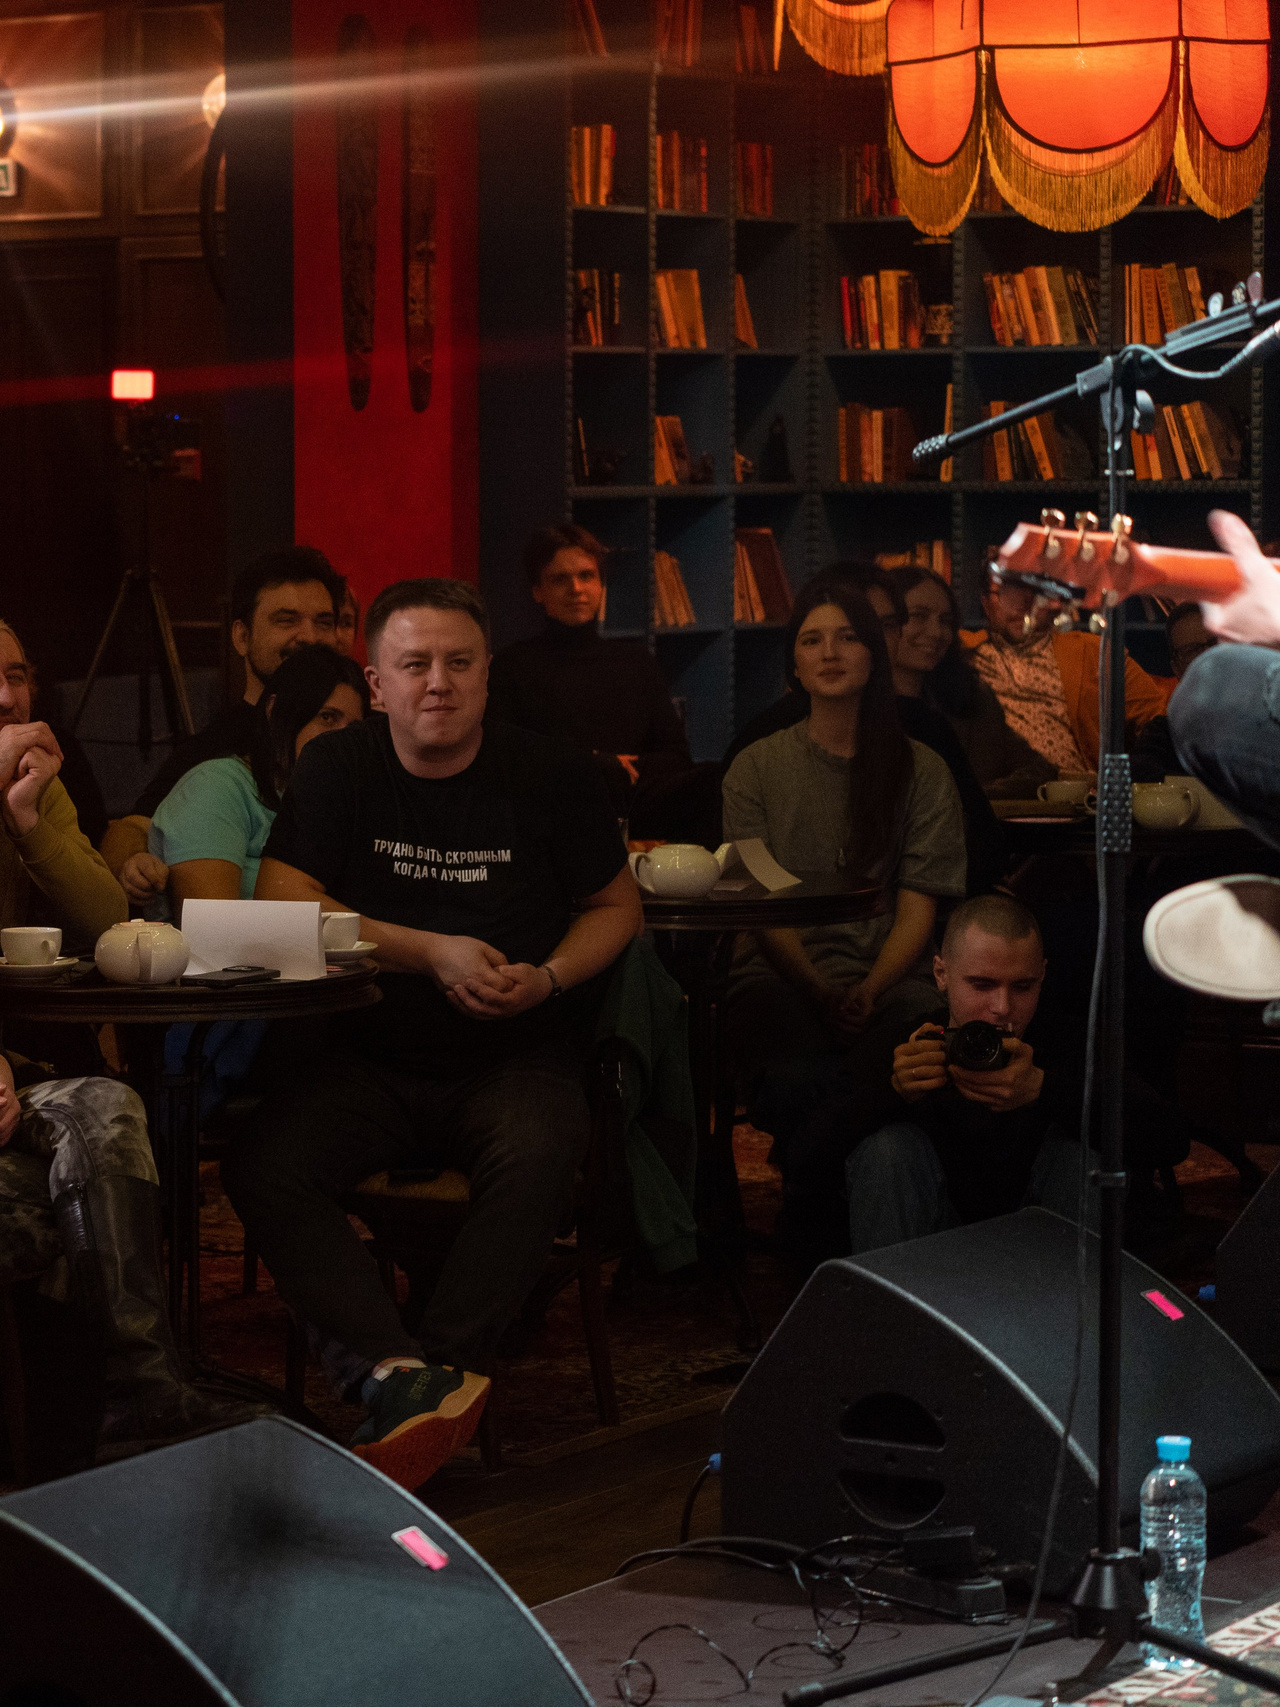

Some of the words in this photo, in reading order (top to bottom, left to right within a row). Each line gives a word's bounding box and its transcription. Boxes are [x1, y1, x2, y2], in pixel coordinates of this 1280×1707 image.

[374, 839, 414, 858] ТРУДНО
[445, 849, 511, 864] СКРОМНЫМ
[393, 861, 429, 879] КОГДА
[431, 867, 437, 879] Я
[440, 865, 488, 883] ЛУЧШИЙ
